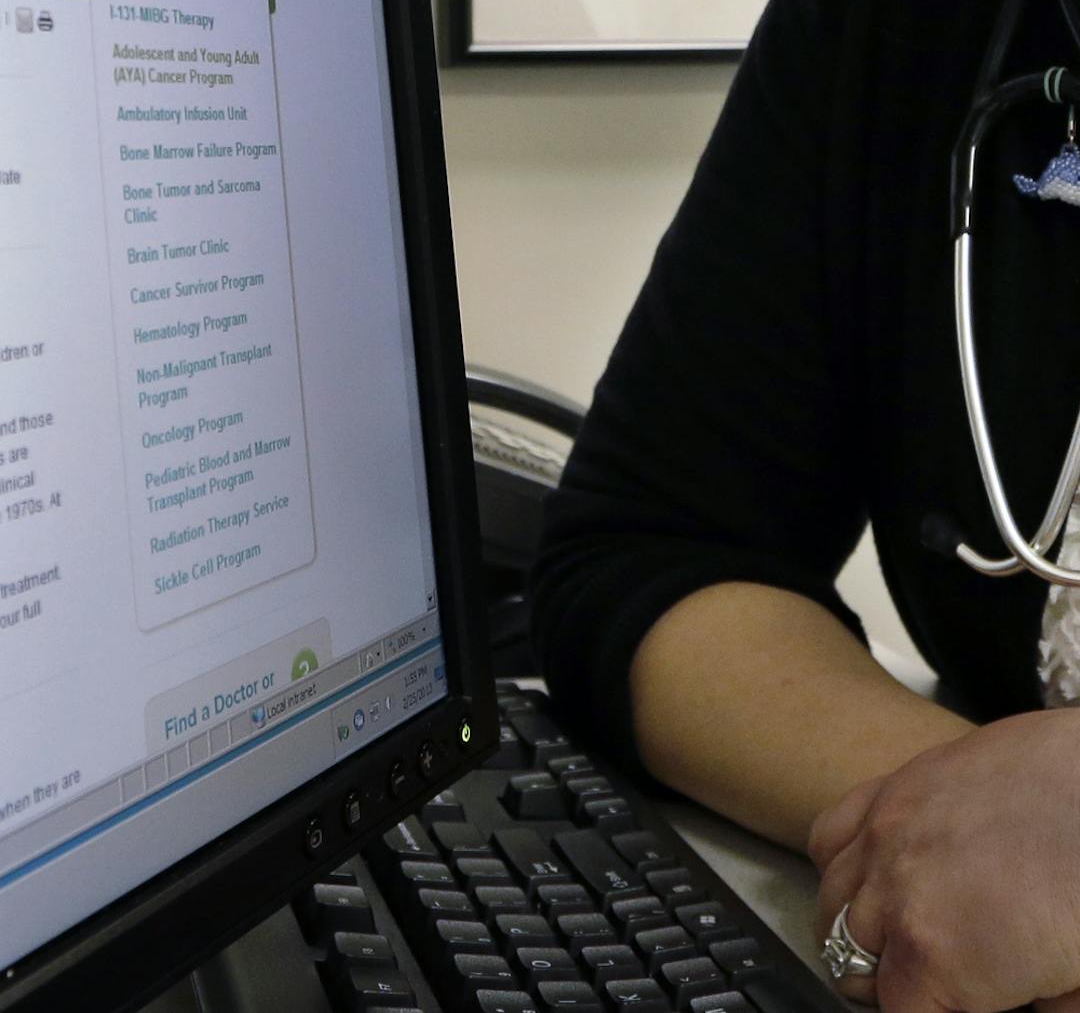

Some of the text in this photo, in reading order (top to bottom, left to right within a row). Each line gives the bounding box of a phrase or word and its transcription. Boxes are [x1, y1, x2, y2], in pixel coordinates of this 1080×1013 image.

[173, 9, 215, 31] Therapy
[112, 43, 260, 67] Adolescent and Young Adult
[113, 66, 234, 87] (AYA) Cancer Program
[116, 106, 248, 124] Ambulatory Infusion Unit
[119, 141, 277, 161] Bone Marrow Failure Program
[122, 179, 261, 201] Bone Tumor and Sarcoma
[124, 206, 157, 224] Clinic
[127, 238, 230, 264] Brain Tumor Clinic
[130, 273, 264, 304] Cancer Survivor Program
[133, 313, 248, 344] Hematology Program
[31, 341, 45, 357] or
[137, 343, 272, 385] Non-Malignant Transplant
[138, 386, 188, 409] Program
[19, 413, 53, 431] those
[142, 411, 244, 449] Oncology Program
[9, 447, 28, 463] are
[145, 435, 291, 489] Pediatric Blood and Marrow
[147, 469, 254, 514] Transplant Program
[150, 495, 289, 555] Radiation Therapy Service
[154, 543, 261, 595] Sickle Cell Program
[22, 599, 41, 620] full
[164, 672, 275, 740] Find a Doctor or
[267, 698, 287, 719] Local
[32, 781, 59, 804] they
[62, 770, 81, 789] are
